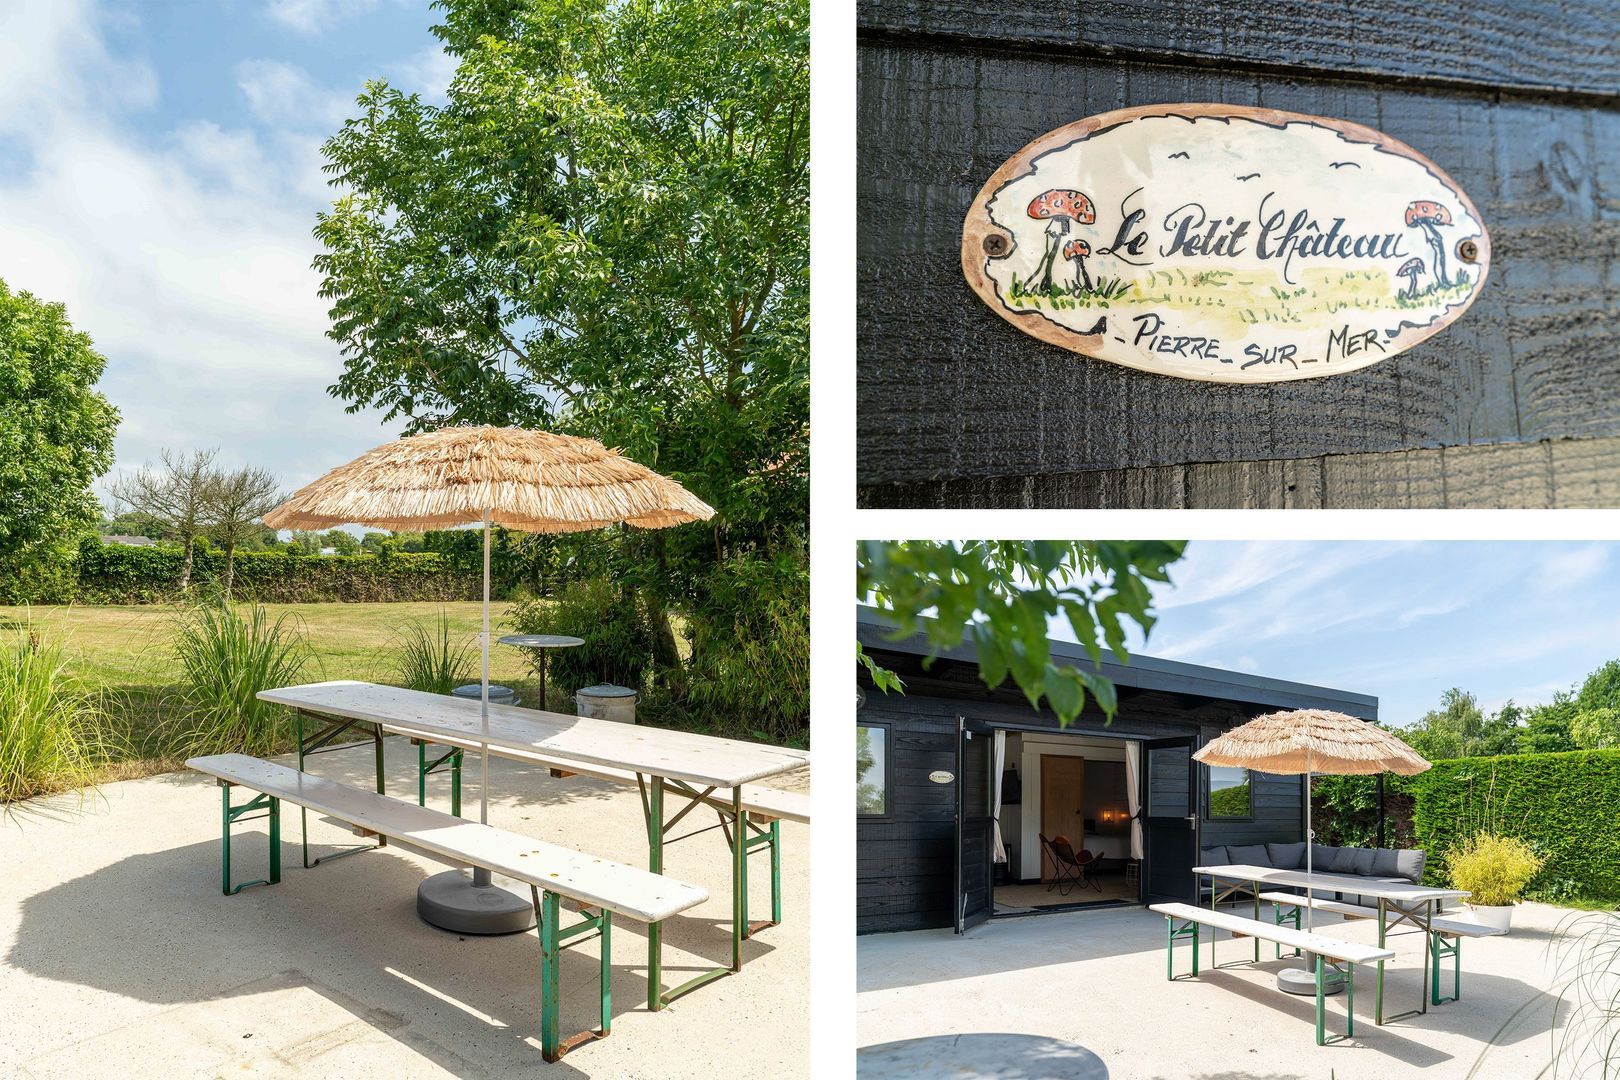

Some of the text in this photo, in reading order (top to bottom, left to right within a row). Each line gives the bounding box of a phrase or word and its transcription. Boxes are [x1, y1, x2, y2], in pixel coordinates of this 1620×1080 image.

[1096, 188, 1409, 285] Le Petit Château
